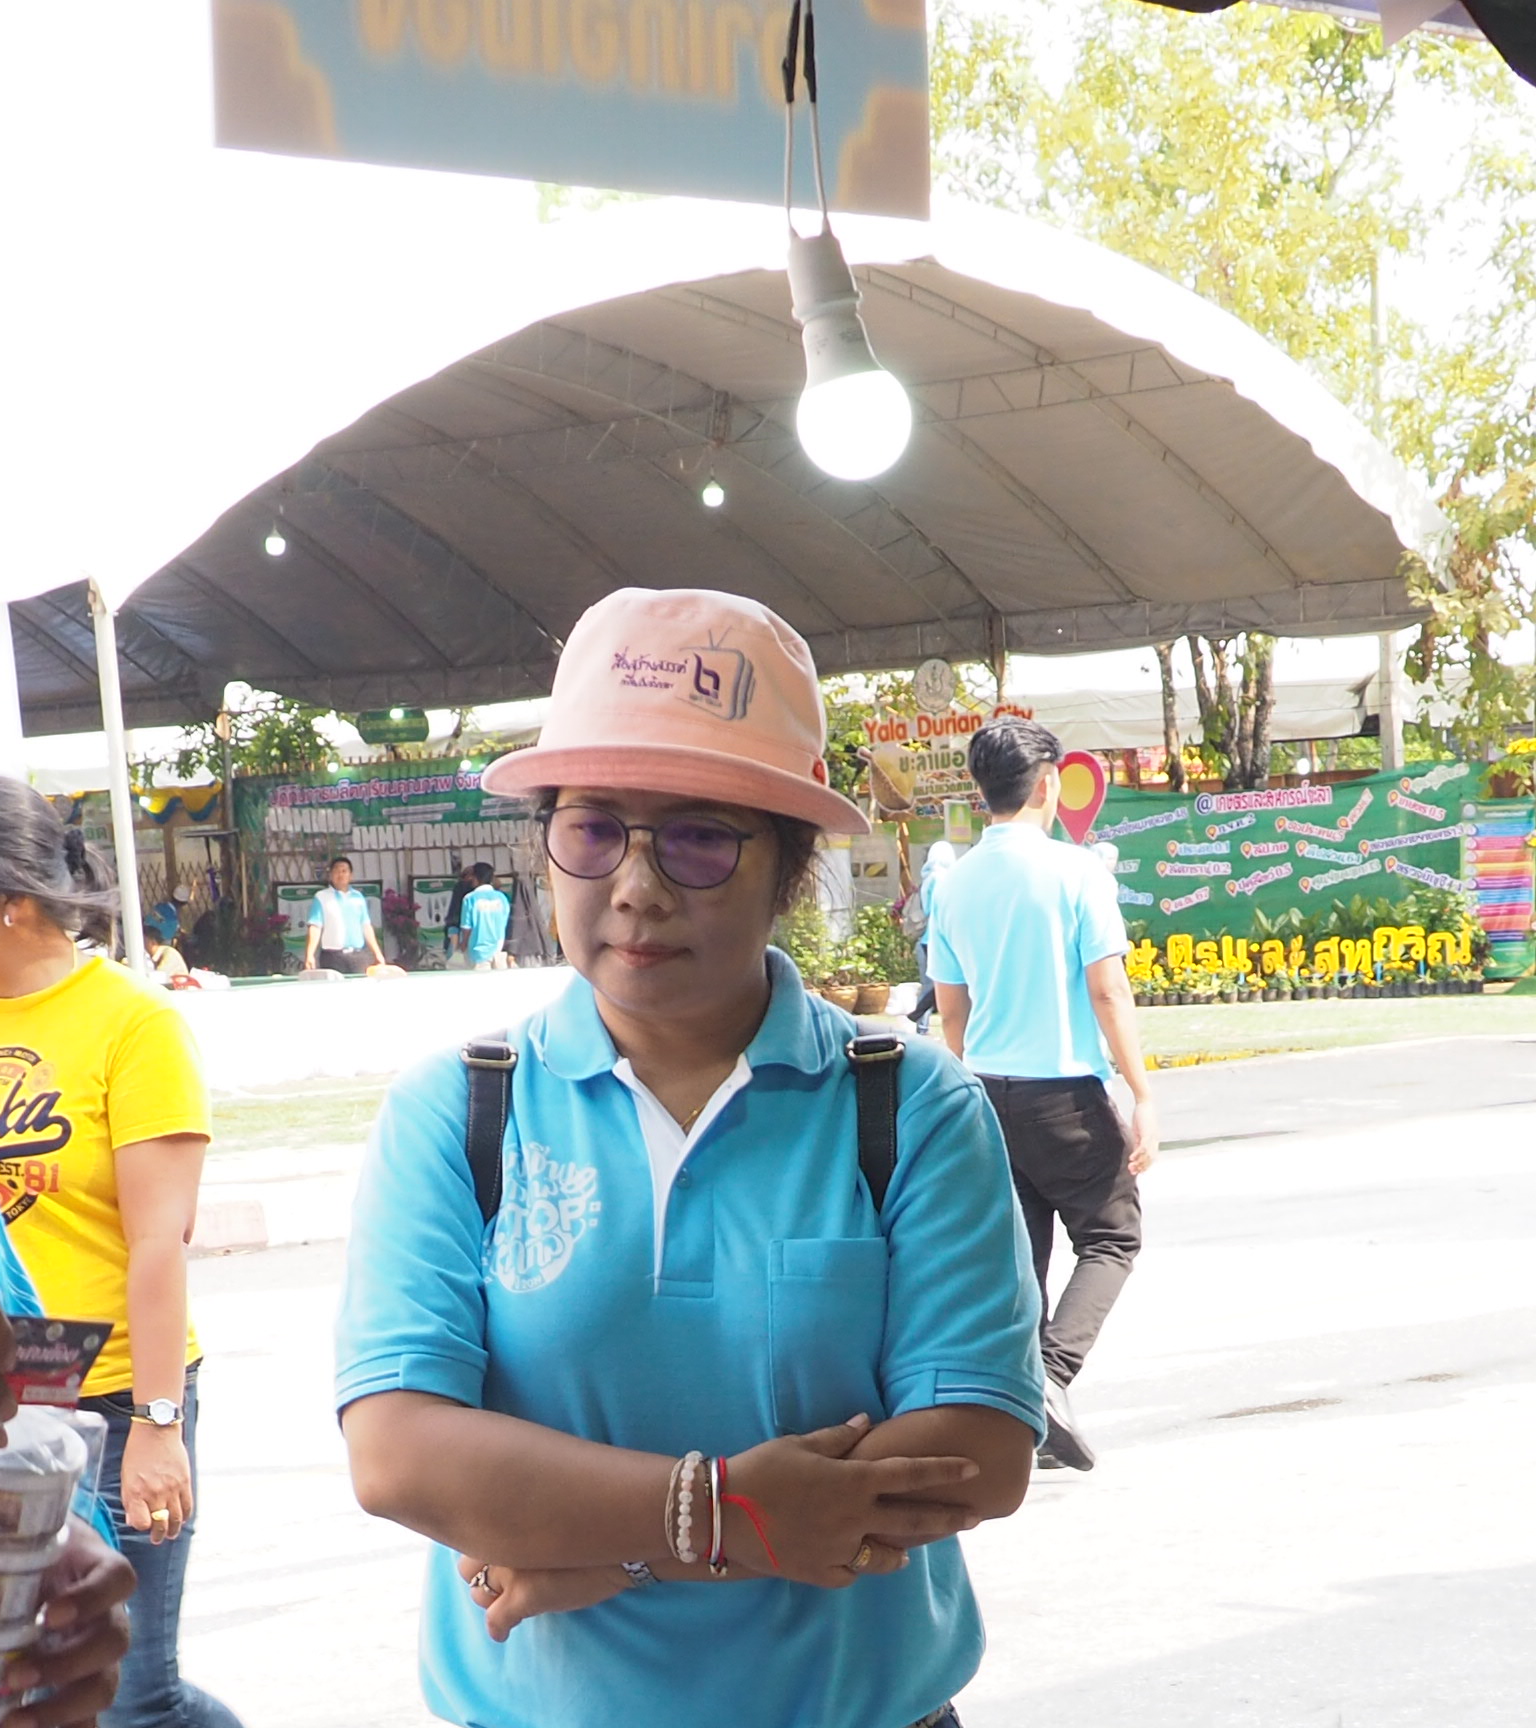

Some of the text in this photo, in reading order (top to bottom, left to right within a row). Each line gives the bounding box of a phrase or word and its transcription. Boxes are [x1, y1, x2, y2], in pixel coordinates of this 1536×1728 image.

[864, 717, 908, 744] Yala
[917, 709, 983, 738] Durian
[900, 744, 966, 773] ยะลาเมือ
[25, 1159, 59, 1193] 81
